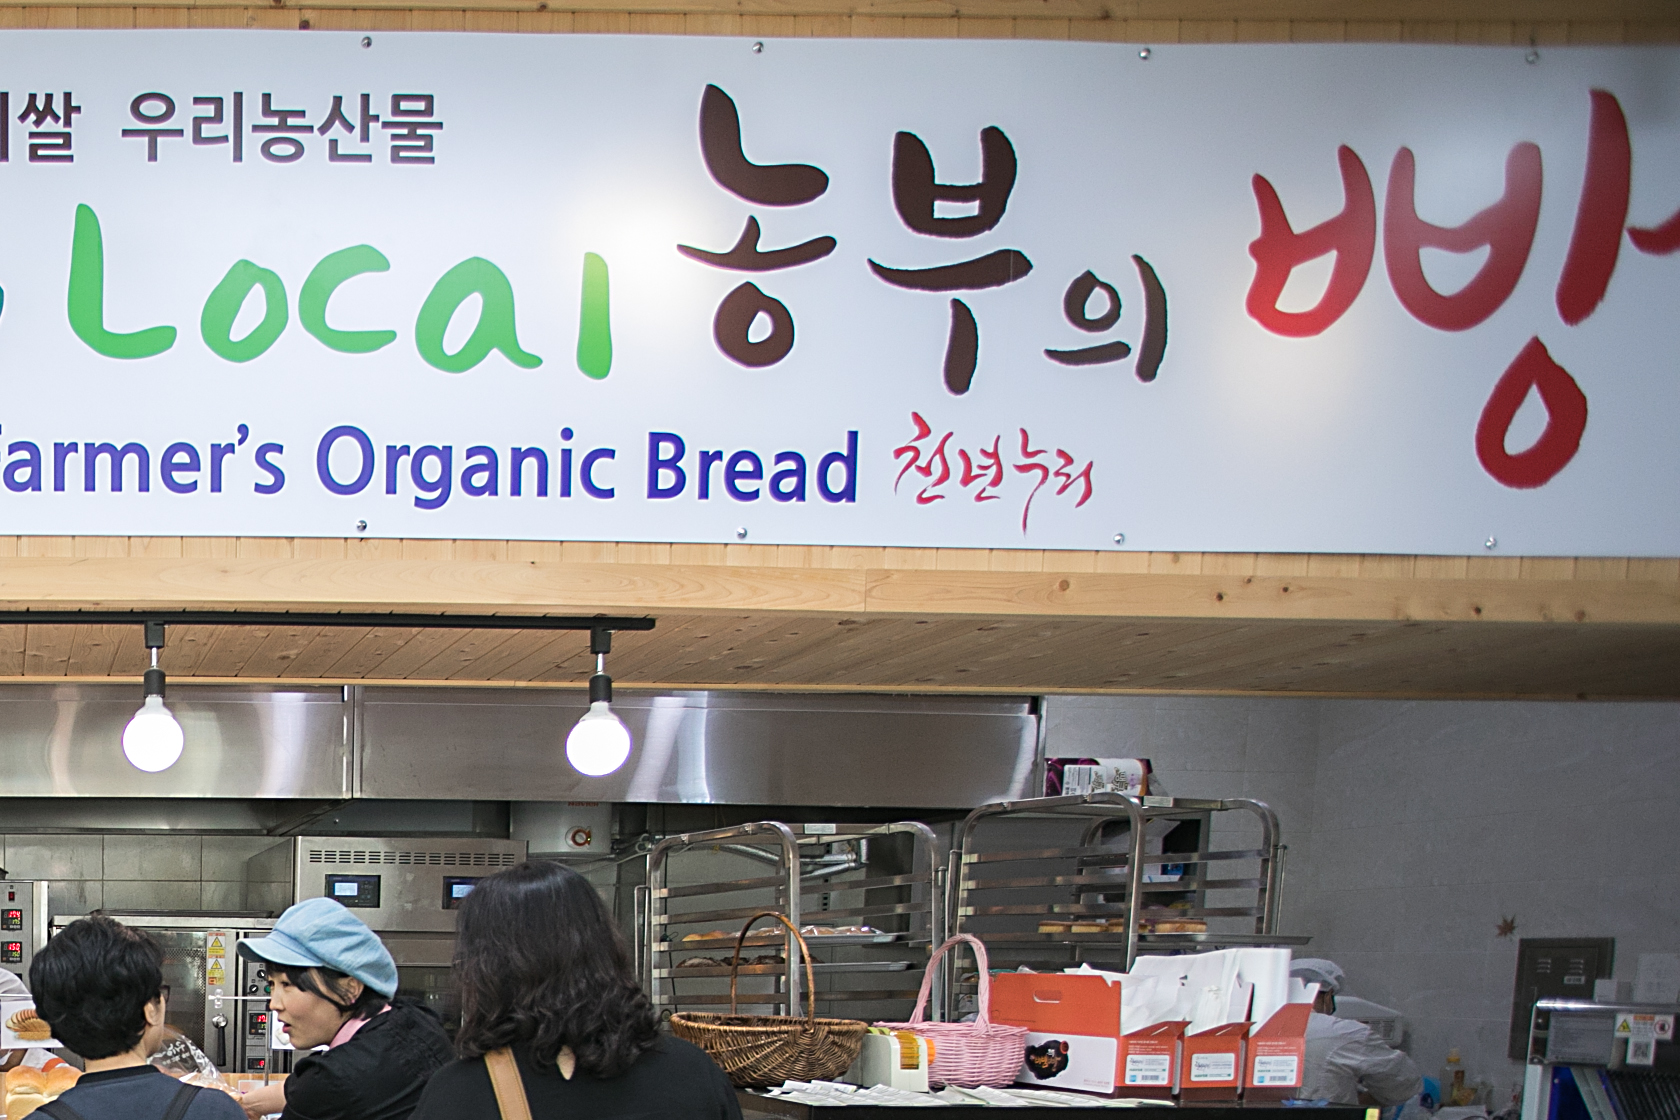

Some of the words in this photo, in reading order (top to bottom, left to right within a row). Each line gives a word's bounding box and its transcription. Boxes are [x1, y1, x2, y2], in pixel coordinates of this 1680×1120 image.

[120, 91, 444, 164] 우리농산물
[67, 202, 612, 380] Local
[676, 84, 1169, 397] 농부의
[1246, 87, 1680, 491] 빵
[315, 425, 616, 511] Organic
[646, 429, 861, 506] Bread
